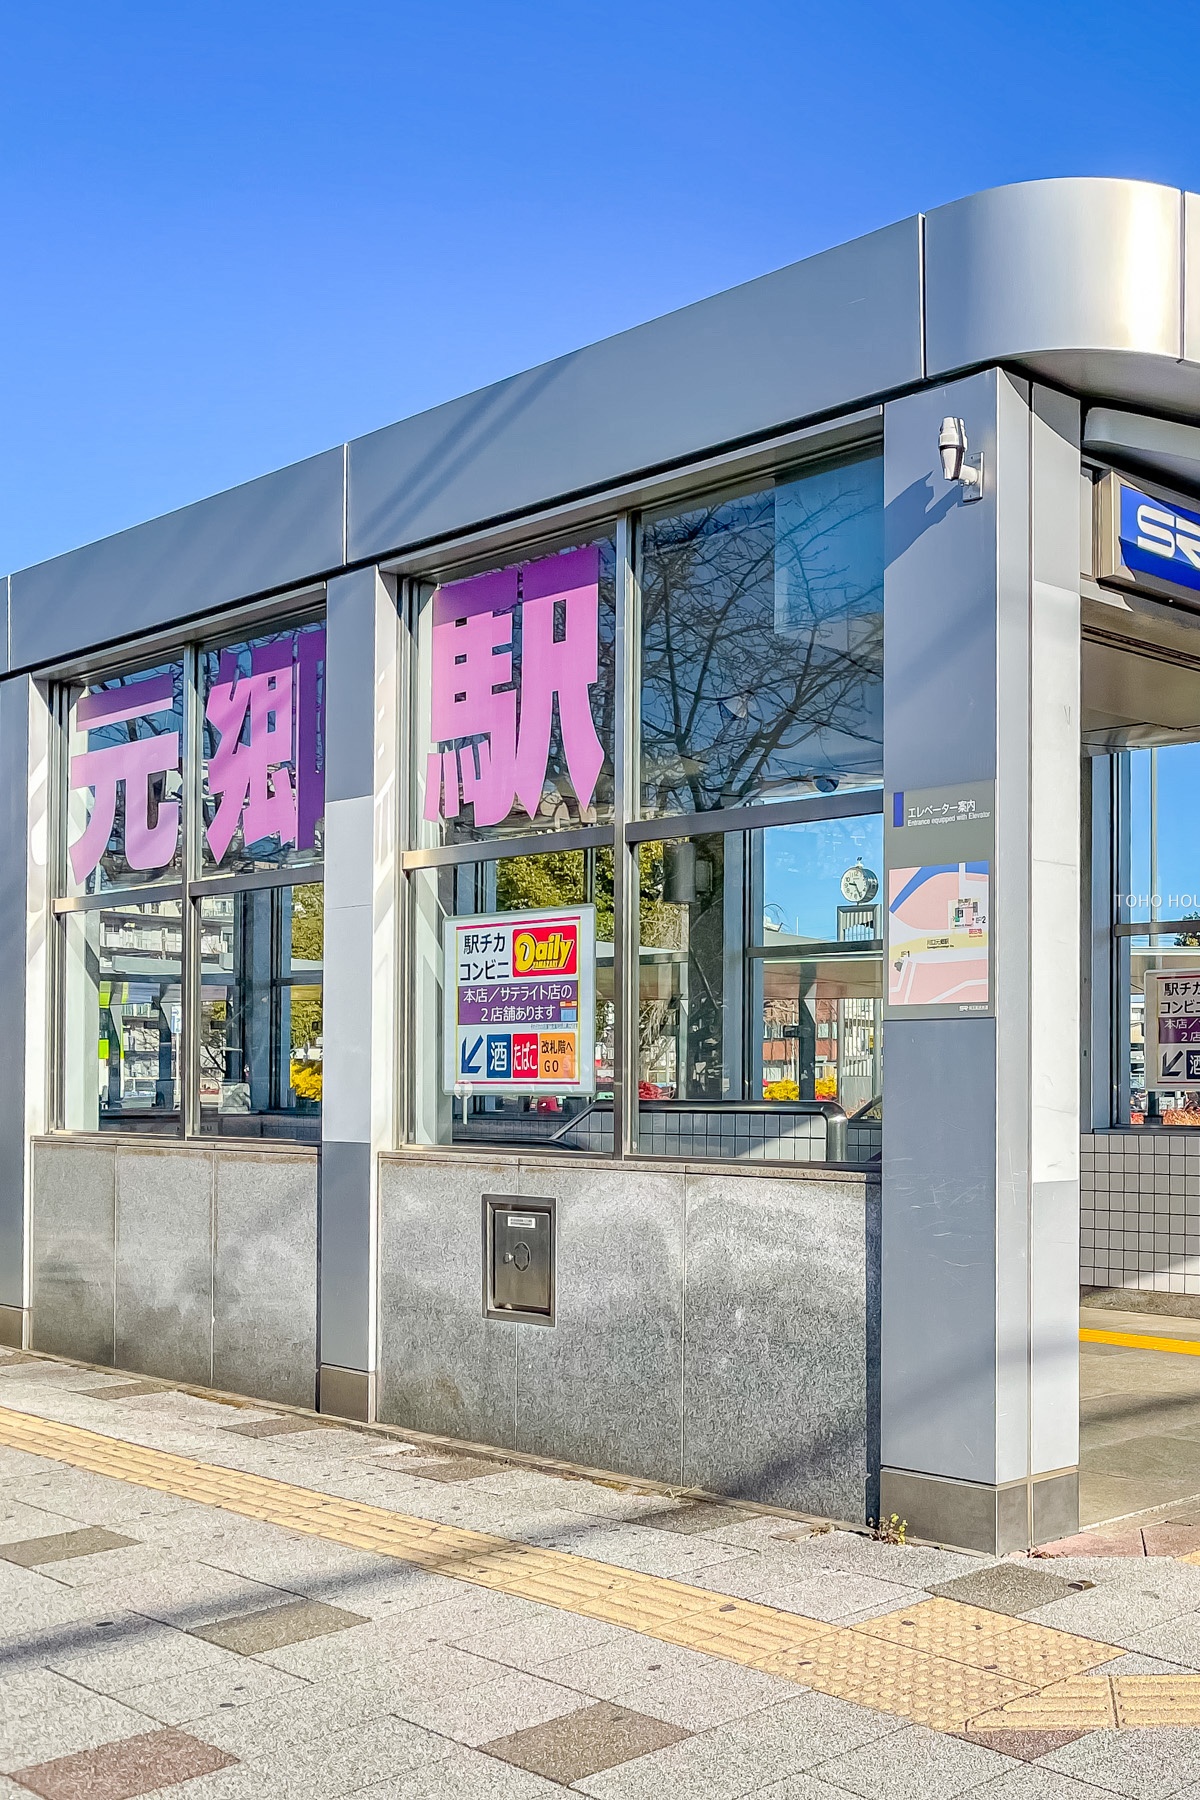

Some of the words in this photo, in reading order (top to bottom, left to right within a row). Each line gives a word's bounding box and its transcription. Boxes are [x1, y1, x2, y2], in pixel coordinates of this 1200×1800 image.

[907, 818, 930, 827] Entrance
[931, 814, 956, 825] equipped
[956, 813, 968, 821] with
[968, 811, 991, 820] Elevator
[908, 799, 976, 818] エレベーター案内
[464, 933, 506, 954] 駅チカ
[515, 933, 573, 971] Daily
[460, 959, 510, 981] コンビニ
[490, 1041, 508, 1071] 酒
[513, 1041, 538, 1071] たばこ
[541, 1040, 573, 1054] 改札階へ
[544, 1060, 559, 1073] GO
